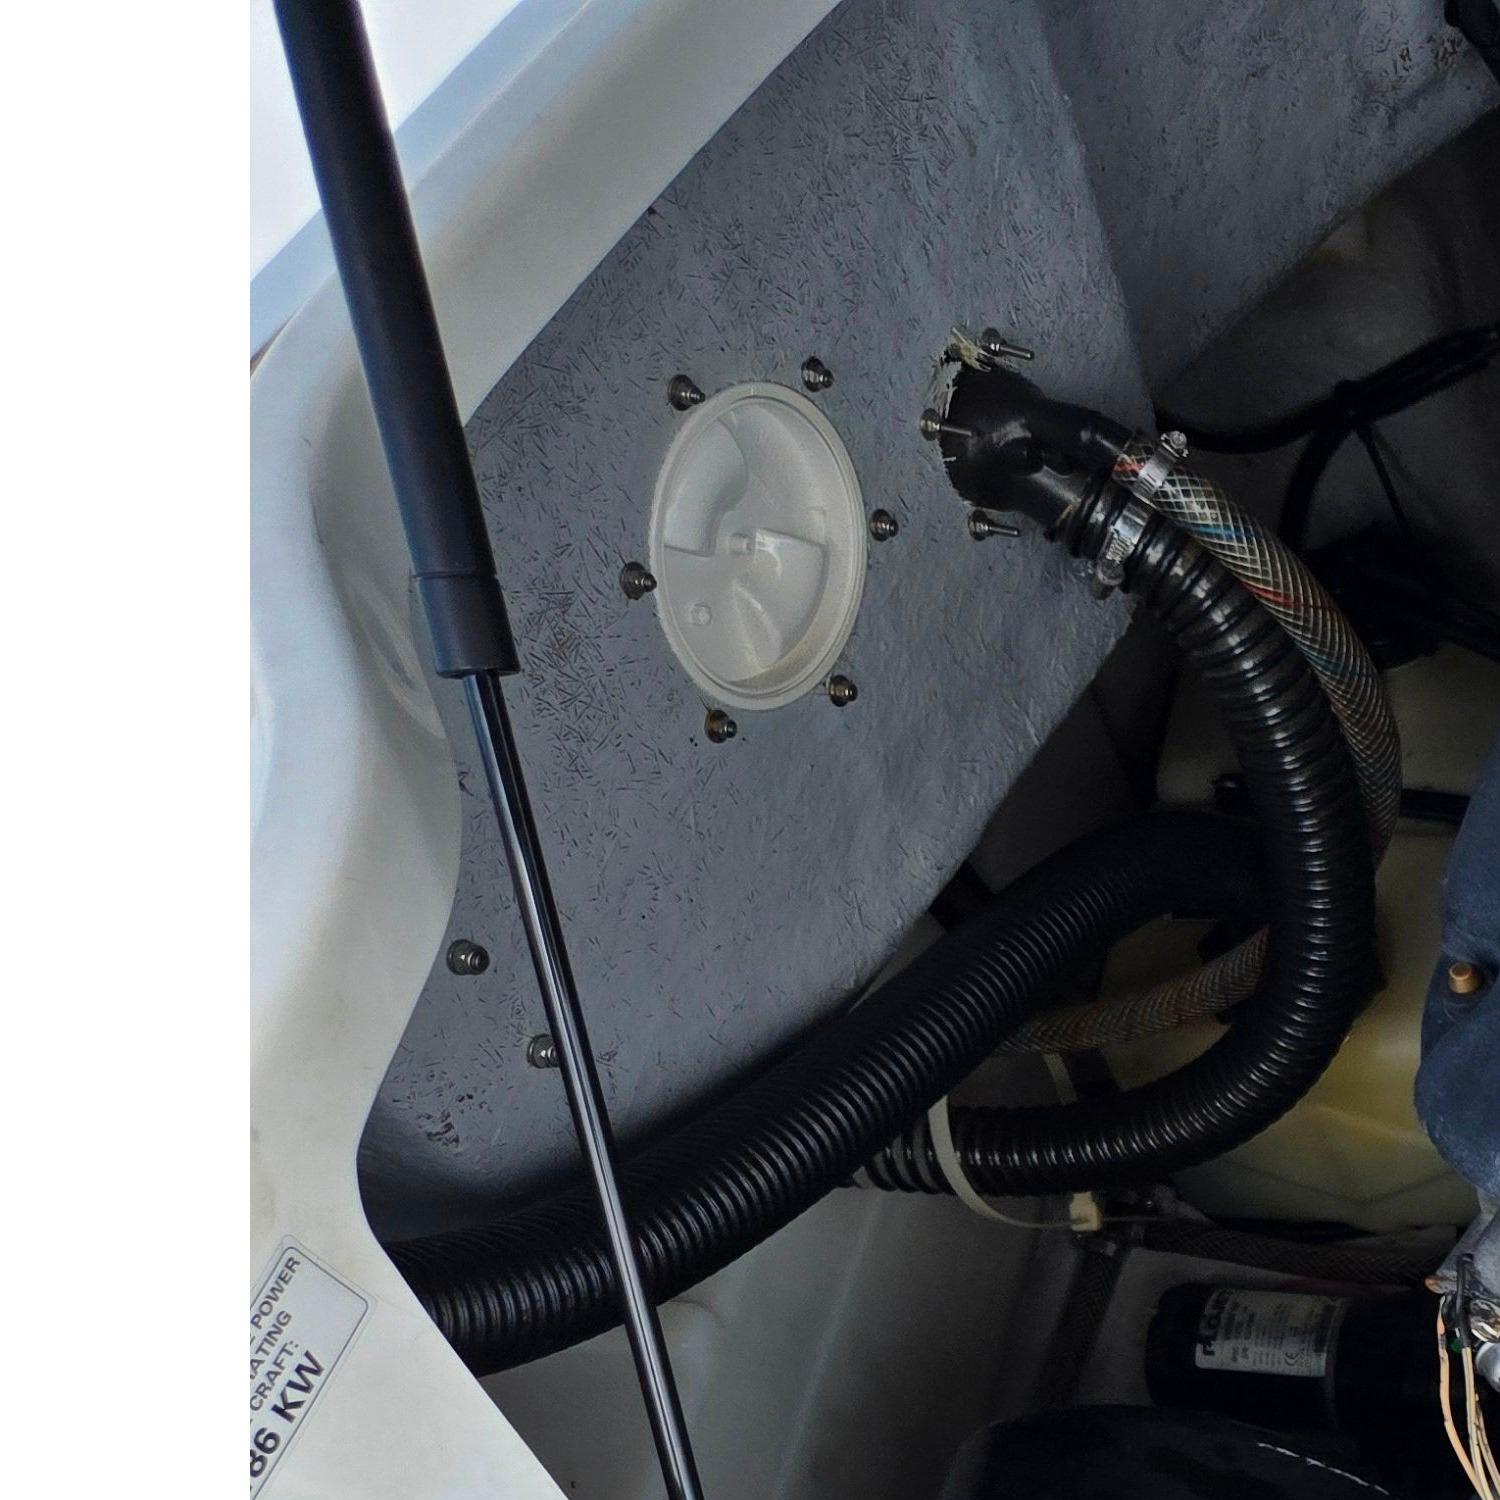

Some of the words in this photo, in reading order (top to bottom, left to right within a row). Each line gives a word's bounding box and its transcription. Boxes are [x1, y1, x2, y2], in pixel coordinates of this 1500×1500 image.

[251, 1256, 301, 1330] POWER
[250, 1310, 292, 1381] ATING
[250, 1339, 299, 1411] CRAFT:
[250, 1427, 281, 1488] 86
[272, 1350, 325, 1423] KW
